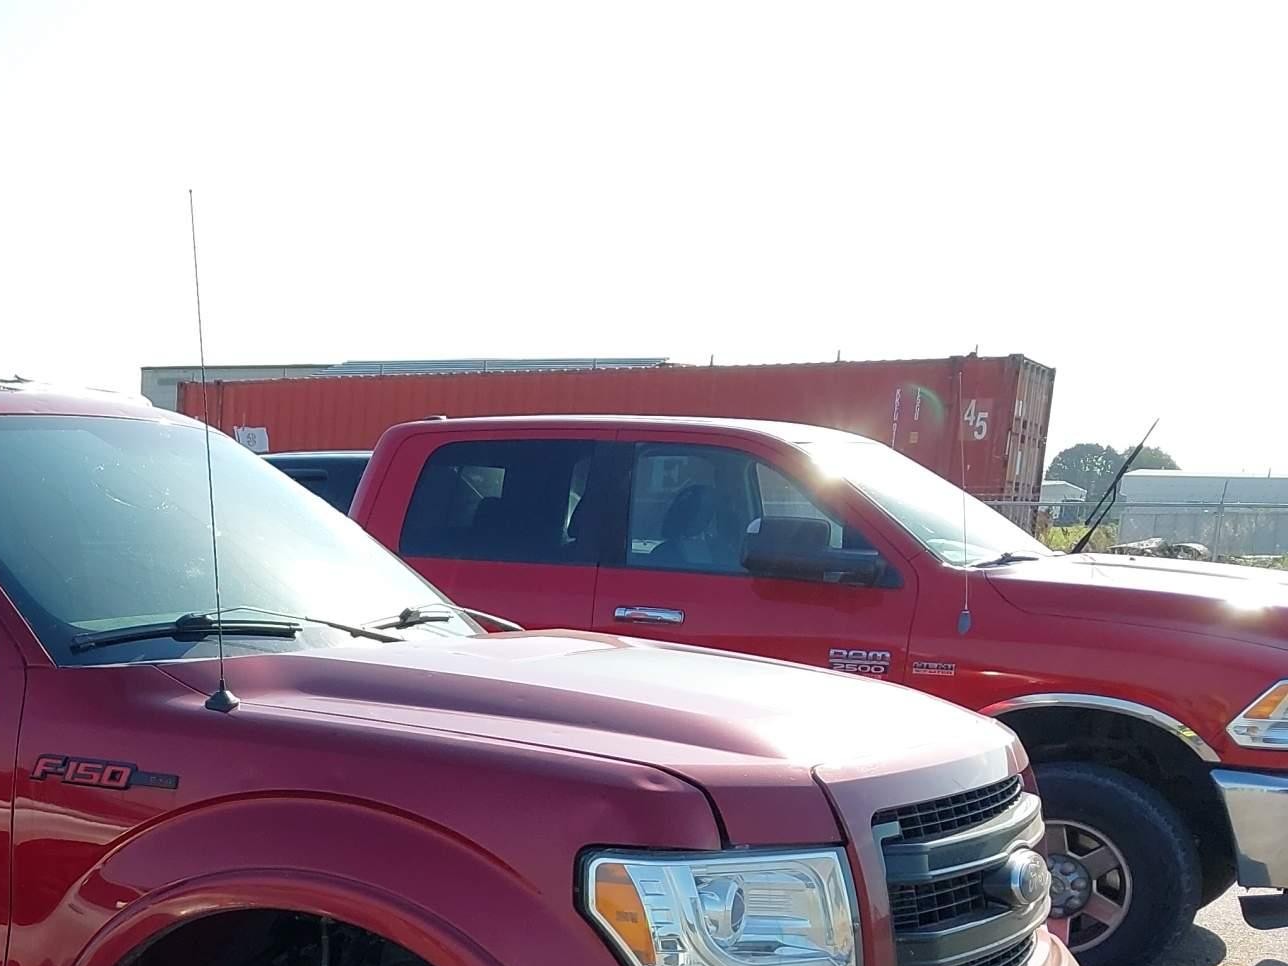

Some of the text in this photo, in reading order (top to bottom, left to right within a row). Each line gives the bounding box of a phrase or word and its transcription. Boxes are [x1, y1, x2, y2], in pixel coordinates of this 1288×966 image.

[964, 399, 989, 440] 45
[829, 648, 891, 665] RAM
[832, 663, 886, 674] 2500
